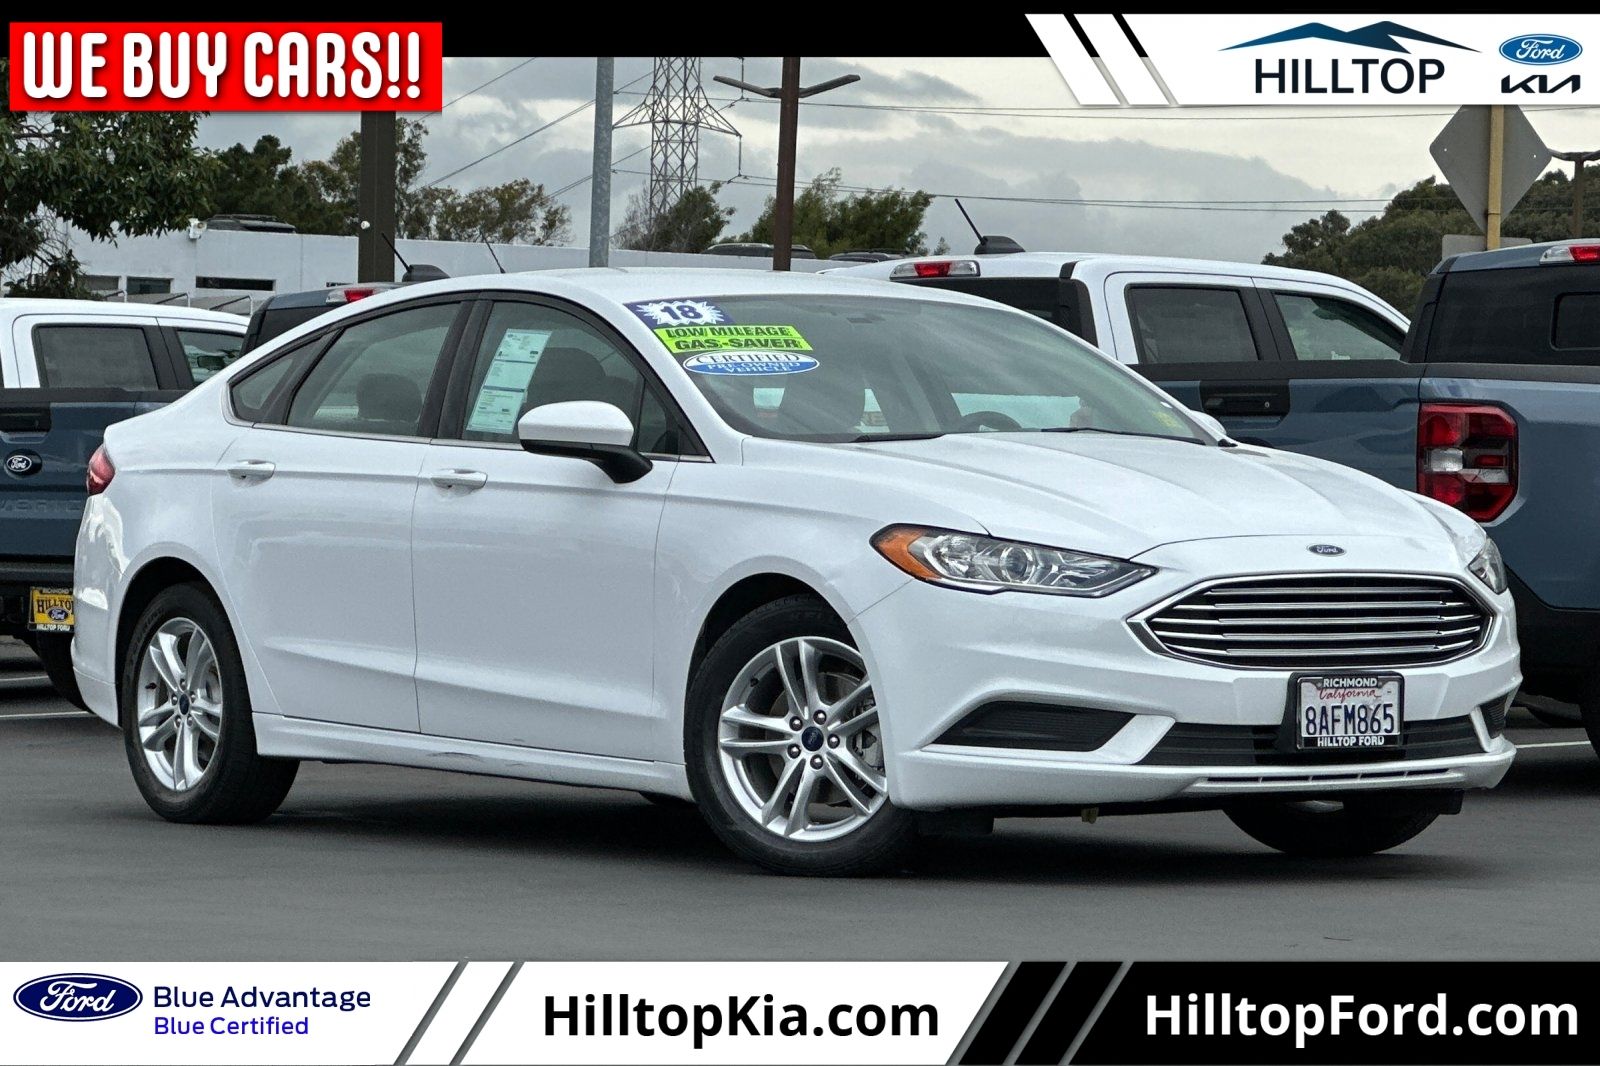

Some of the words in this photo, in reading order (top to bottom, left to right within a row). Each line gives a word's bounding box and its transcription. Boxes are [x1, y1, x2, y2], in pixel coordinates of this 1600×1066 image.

[661, 304, 702, 320] 18
[665, 327, 707, 338] LOW
[711, 327, 792, 336] MILEAGE
[696, 354, 800, 363] CERTIFIED
[10, 457, 27, 469] Ford
[1323, 678, 1377, 687] RICHMOND
[1320, 688, 1382, 704] California
[1305, 703, 1395, 736] 8AFM865
[1317, 736, 1356, 747] HILLTOP
[1358, 735, 1385, 746] FORD
